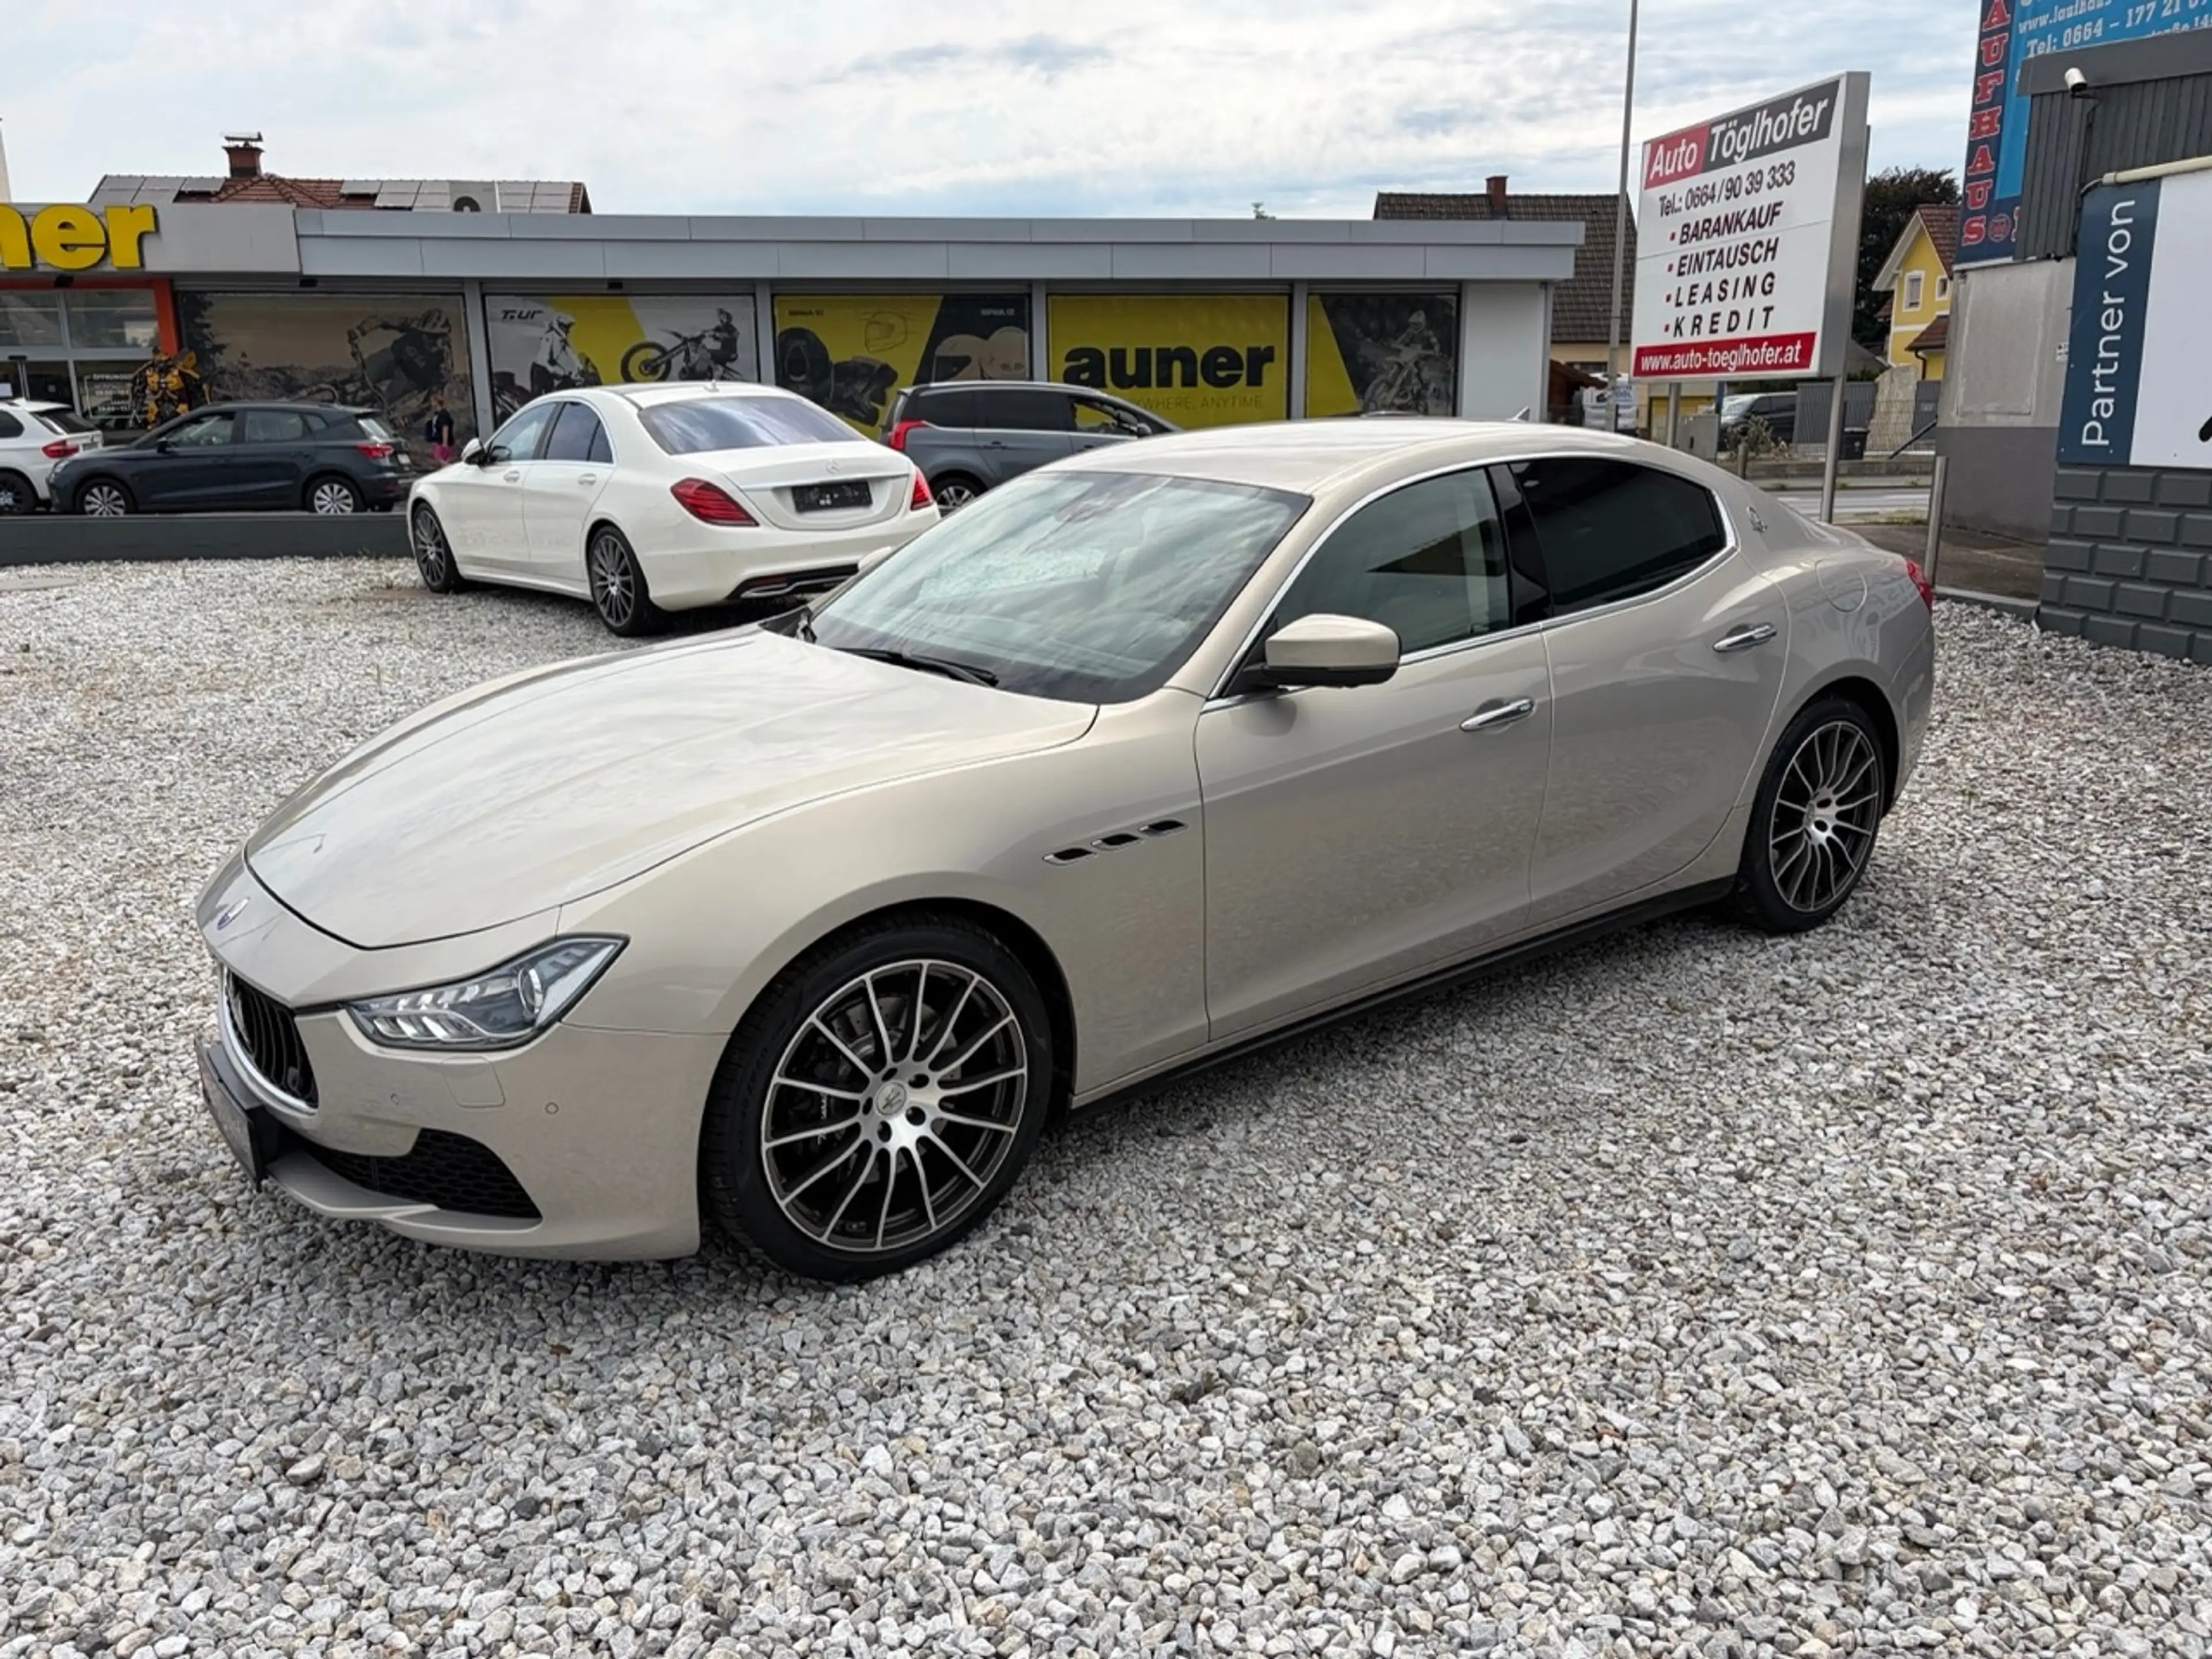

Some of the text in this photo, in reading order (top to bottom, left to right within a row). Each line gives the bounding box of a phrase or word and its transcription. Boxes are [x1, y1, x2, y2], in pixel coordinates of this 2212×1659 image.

[2062, 17, 2103, 48] 0664
[2126, 1, 2156, 28] 177
[1650, 97, 1830, 181] Auto Töglhofer
[1659, 193, 1683, 218] Tel.:
[1745, 169, 1764, 196] 39
[1766, 160, 1796, 191] 333
[1679, 200, 1785, 245] BARANKAUF
[1676, 237, 1780, 278] EINTAUSCH
[1675, 271, 1776, 308] LEASING
[1672, 305, 1775, 338] KREDIT
[2081, 199, 2136, 447] Partner von
[1062, 345, 1275, 390] auner
[1641, 339, 1802, 372] www.auto-toeglhofer.at
